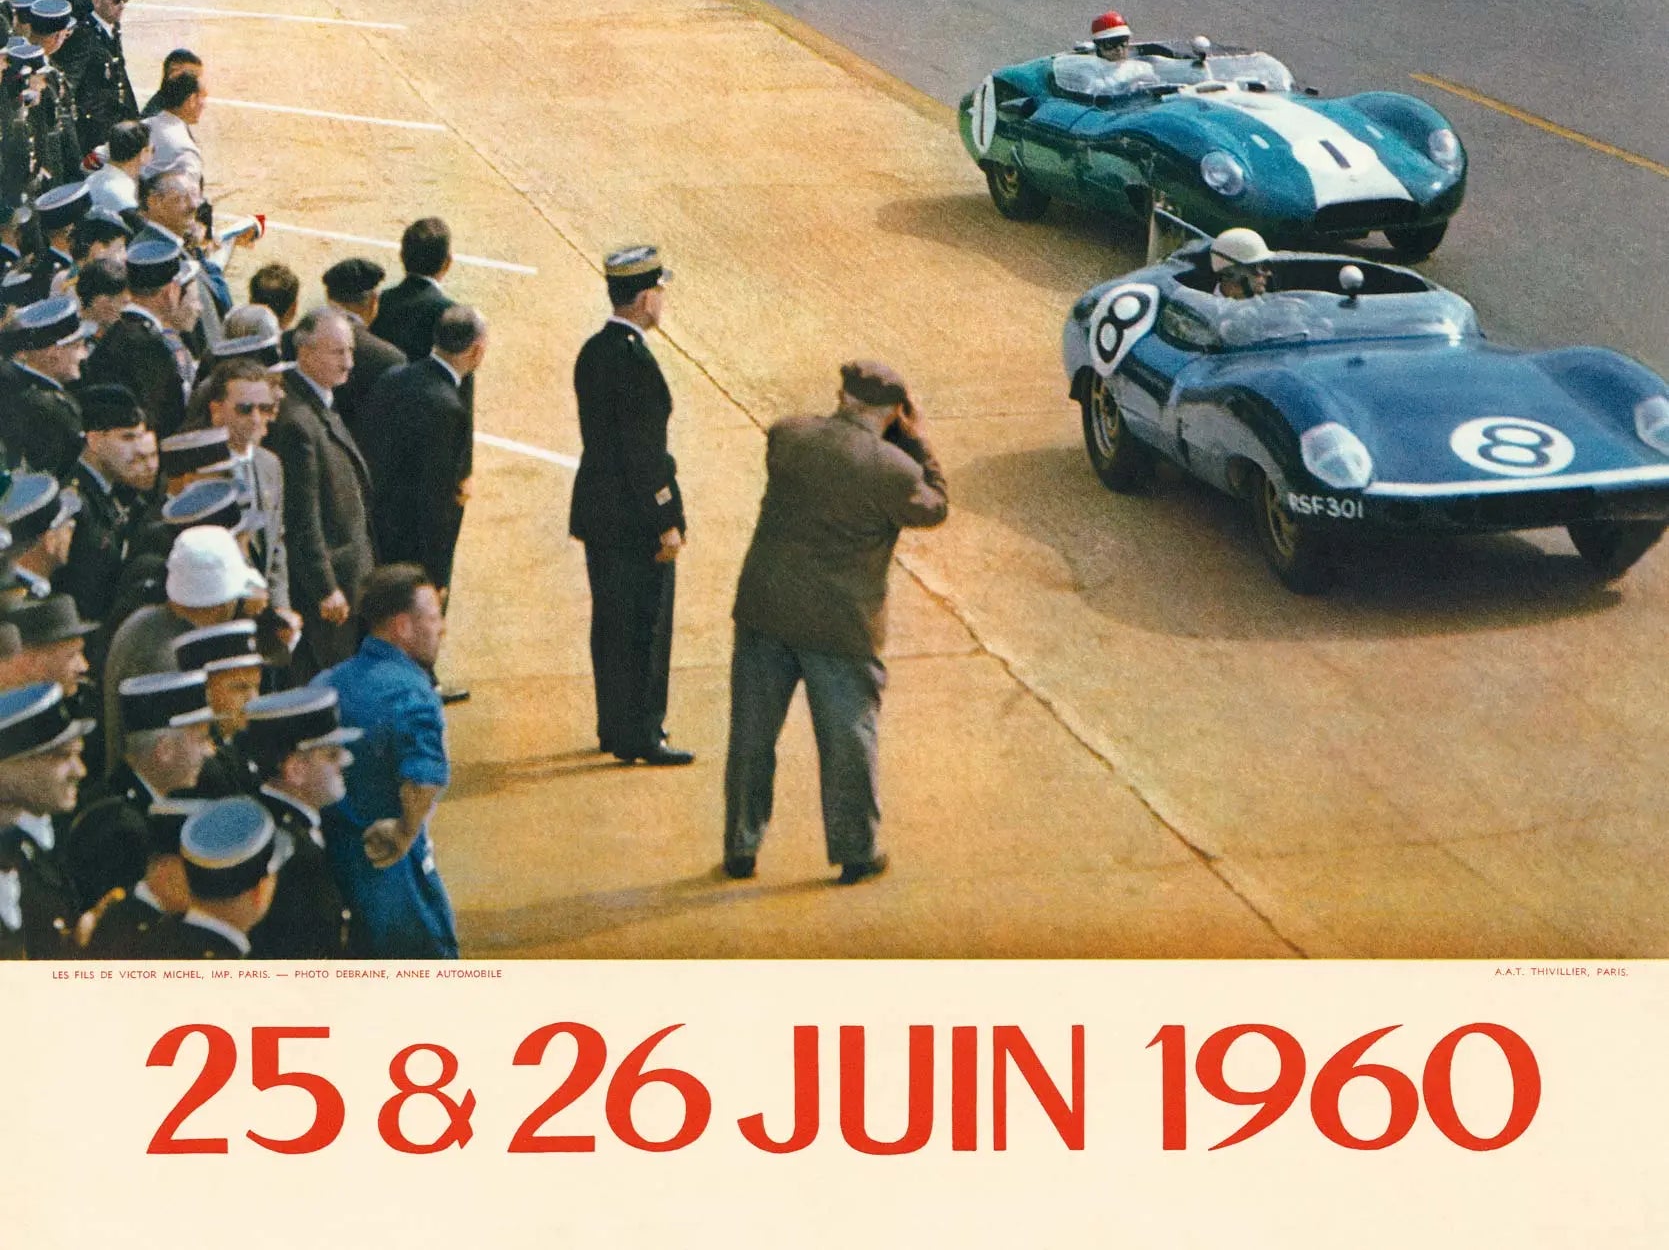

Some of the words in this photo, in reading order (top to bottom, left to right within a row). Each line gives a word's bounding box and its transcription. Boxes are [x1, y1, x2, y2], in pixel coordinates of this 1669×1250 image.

[1318, 139, 1352, 169] 1
[1096, 290, 1152, 364] 8
[1477, 423, 1555, 469] 8
[52, 970, 70, 980] LES
[74, 970, 95, 980] FILS
[100, 970, 113, 980] DE
[118, 970, 158, 980] VICTOR
[162, 969, 205, 981] MICHEL,
[211, 969, 233, 979] IMP.
[238, 969, 271, 979] PARIS.
[294, 969, 330, 979] PHOTO
[335, 969, 389, 980] DEBRAINE,
[395, 969, 431, 979] ANNEE
[436, 969, 503, 979] AUTOMOBILE
[1530, 967, 1590, 978] THIVILLIER,
[1597, 967, 1629, 977] PARIS.
[145, 1023, 346, 1155] 25
[377, 1042, 477, 1155] &
[507, 1021, 712, 1154] 26
[736, 1023, 1087, 1155] JUIN
[1146, 1021, 1542, 1152] 1960
